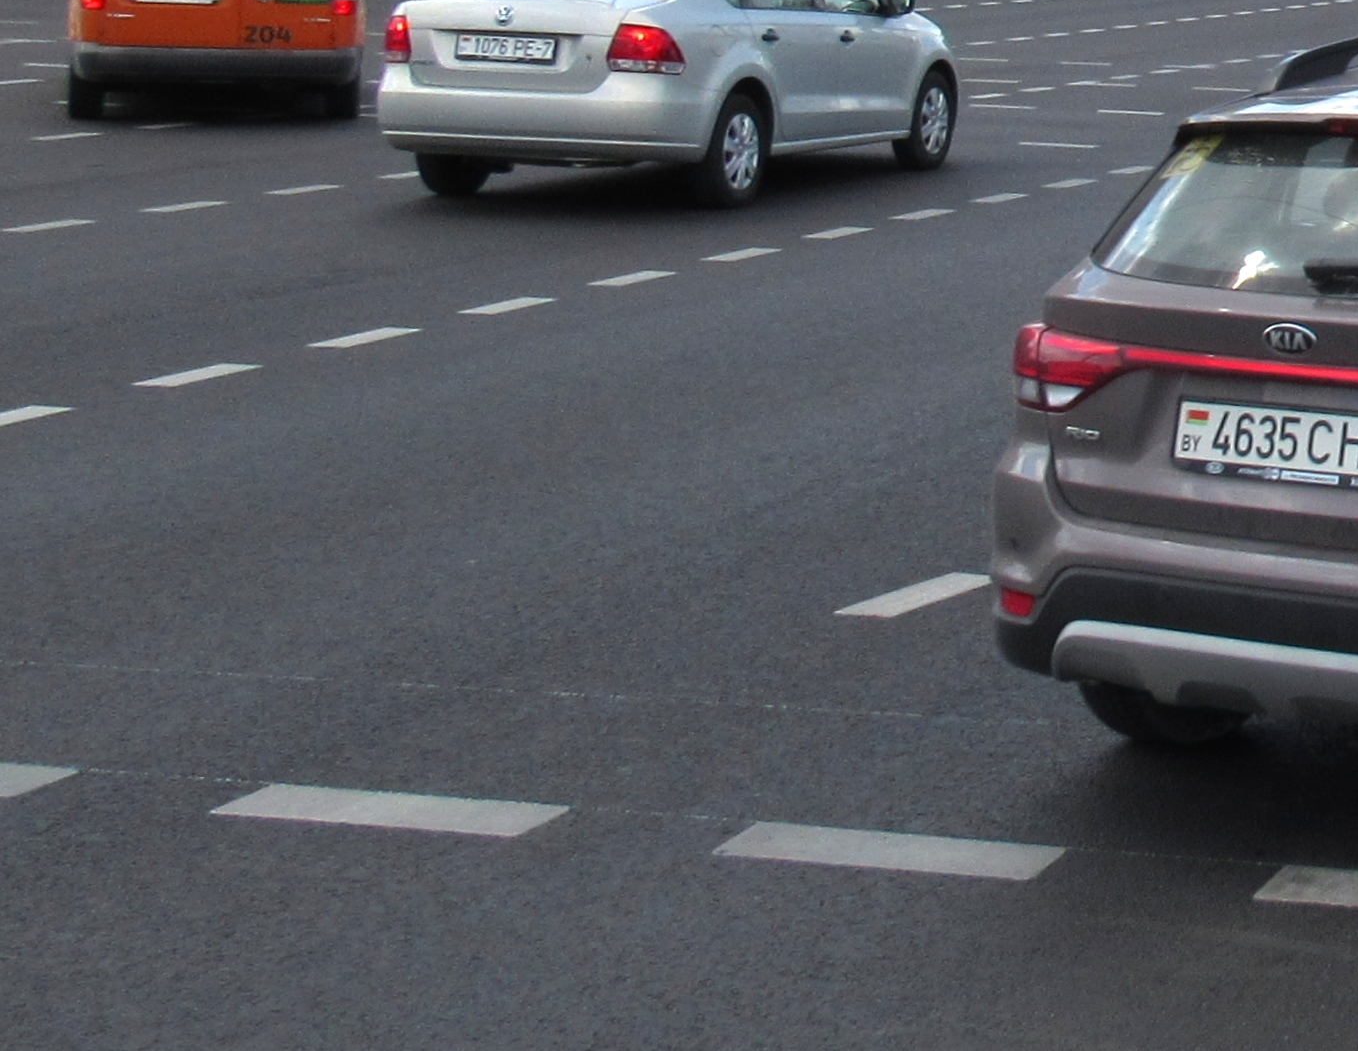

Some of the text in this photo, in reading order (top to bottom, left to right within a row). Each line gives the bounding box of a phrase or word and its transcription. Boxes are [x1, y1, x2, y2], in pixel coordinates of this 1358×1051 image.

[244, 25, 292, 43] 204
[1269, 330, 1308, 351] KIA
[1181, 434, 1202, 453] BY
